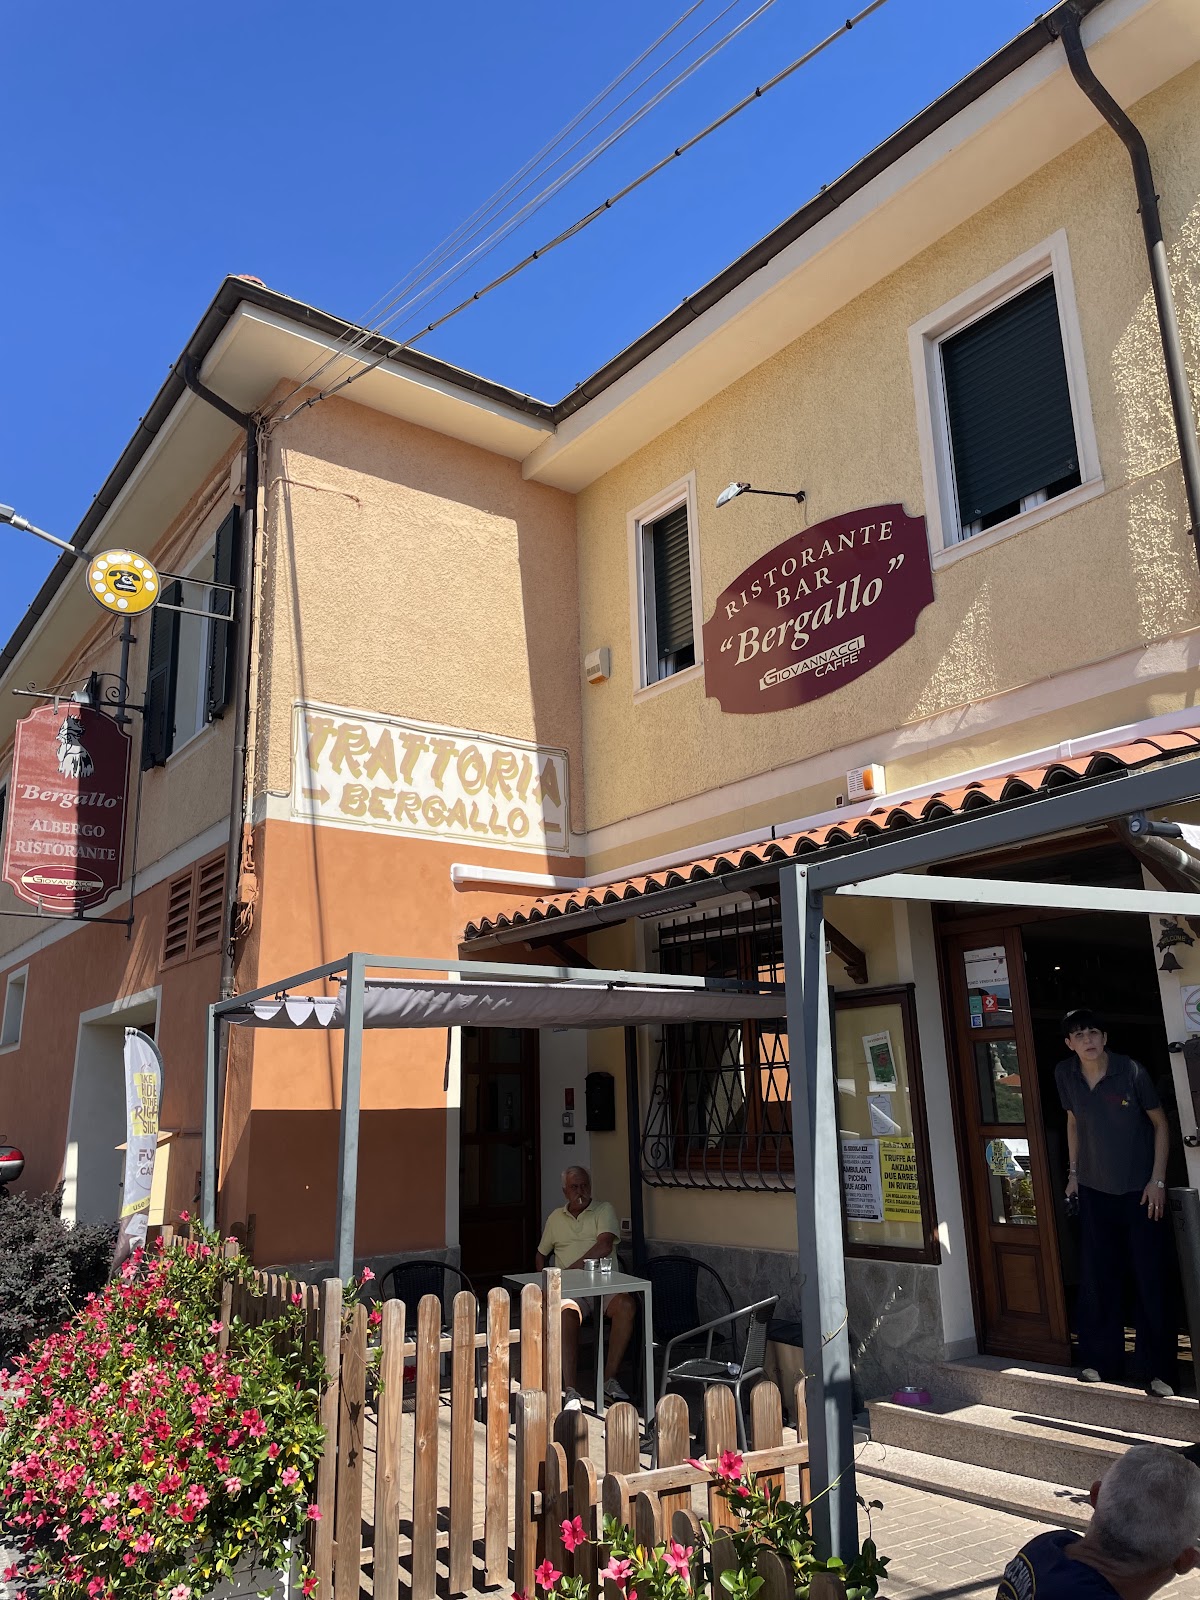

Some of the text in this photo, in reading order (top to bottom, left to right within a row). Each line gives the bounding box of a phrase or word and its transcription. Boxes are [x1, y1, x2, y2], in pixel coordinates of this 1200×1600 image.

[725, 520, 893, 620] RISTORANTE
[776, 566, 833, 609] BAR
[763, 639, 860, 685] GIOVANNACCI
[305, 715, 561, 808] TRATTORIA
[338, 782, 530, 838] BERGALLO
[30, 819, 105, 838] ALBERGO
[15, 840, 117, 860] RISTORANTE
[32, 874, 94, 886] GIOVANNACCI
[884, 1154, 906, 1162] TRUFFE
[891, 1163, 916, 1172] ANZIANI
[848, 1174, 868, 1182] PICCHIA
[884, 1172, 897, 1180] DUE
[855, 1183, 872, 1191] AGENTI
[888, 1181, 896, 1189] IN
